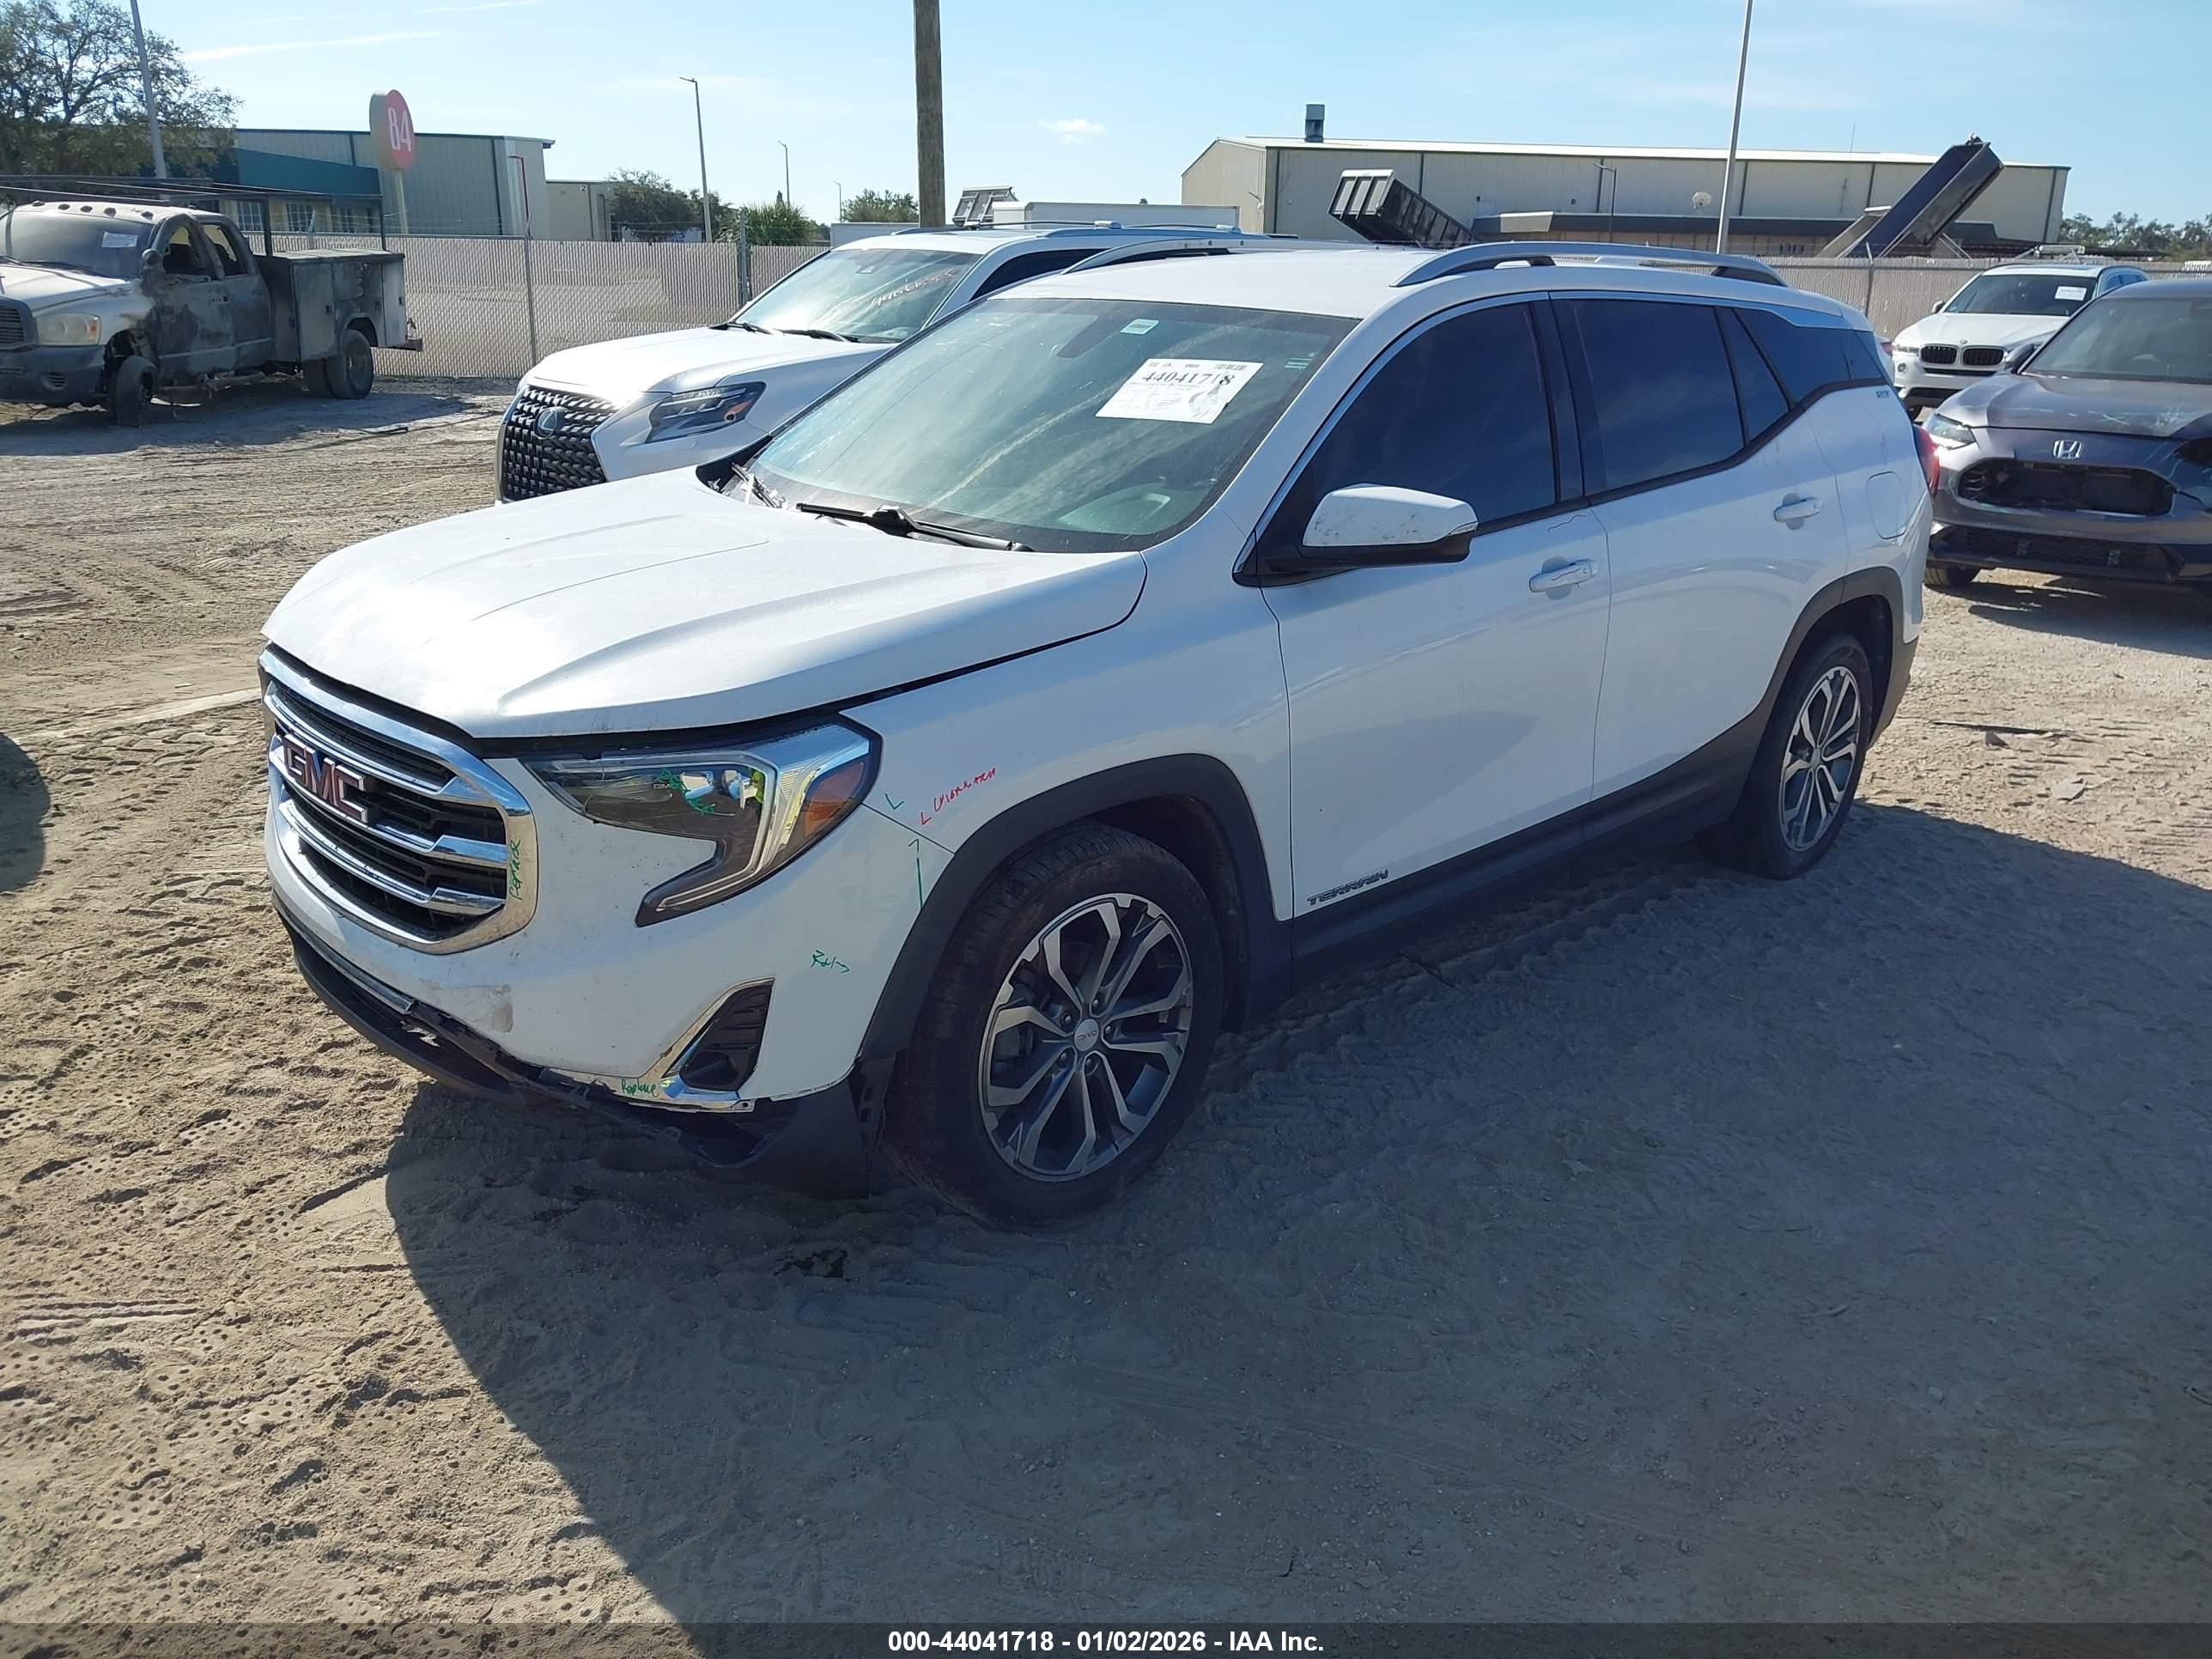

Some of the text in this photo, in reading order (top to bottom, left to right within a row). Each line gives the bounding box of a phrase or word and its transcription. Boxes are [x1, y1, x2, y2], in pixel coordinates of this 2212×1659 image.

[387, 106, 413, 152] 84
[1142, 371, 1235, 386] 44041718
[282, 733, 368, 824] GMC
[1306, 868, 1389, 906] TERRAIN
[1077, 1030, 1097, 1042] GMC
